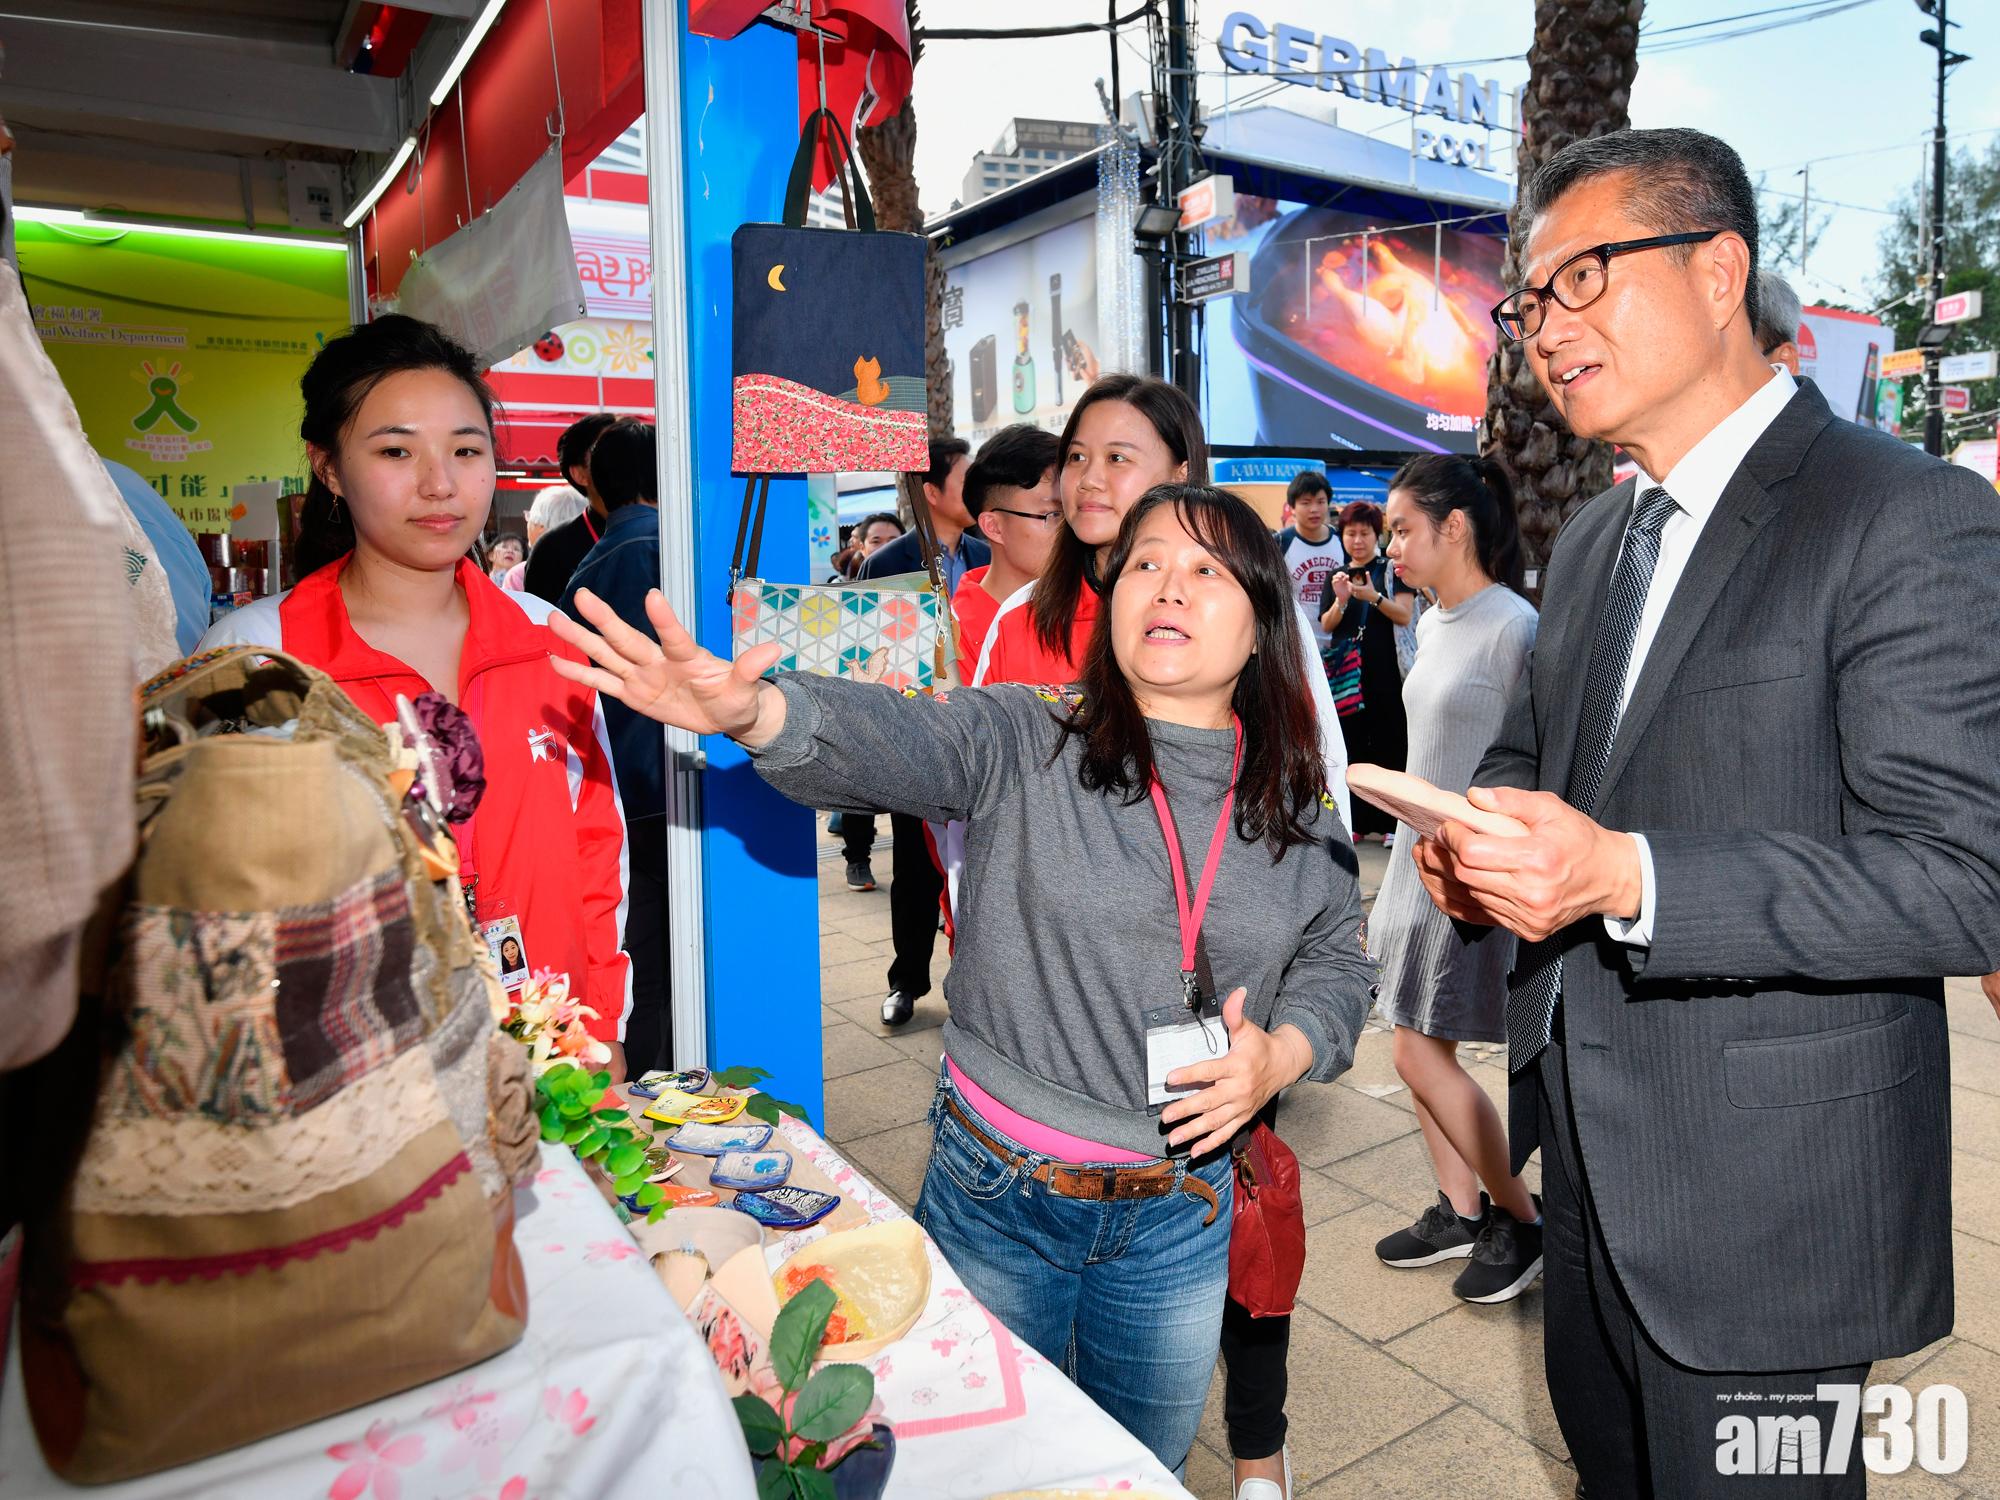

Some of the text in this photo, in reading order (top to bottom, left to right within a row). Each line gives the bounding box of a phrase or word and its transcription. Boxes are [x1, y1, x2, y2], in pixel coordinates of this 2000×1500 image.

[1217, 11, 1499, 131] GERMAN
[1412, 128, 1495, 171] POOL
[58, 325, 106, 340] Welfare
[110, 327, 185, 345] Department
